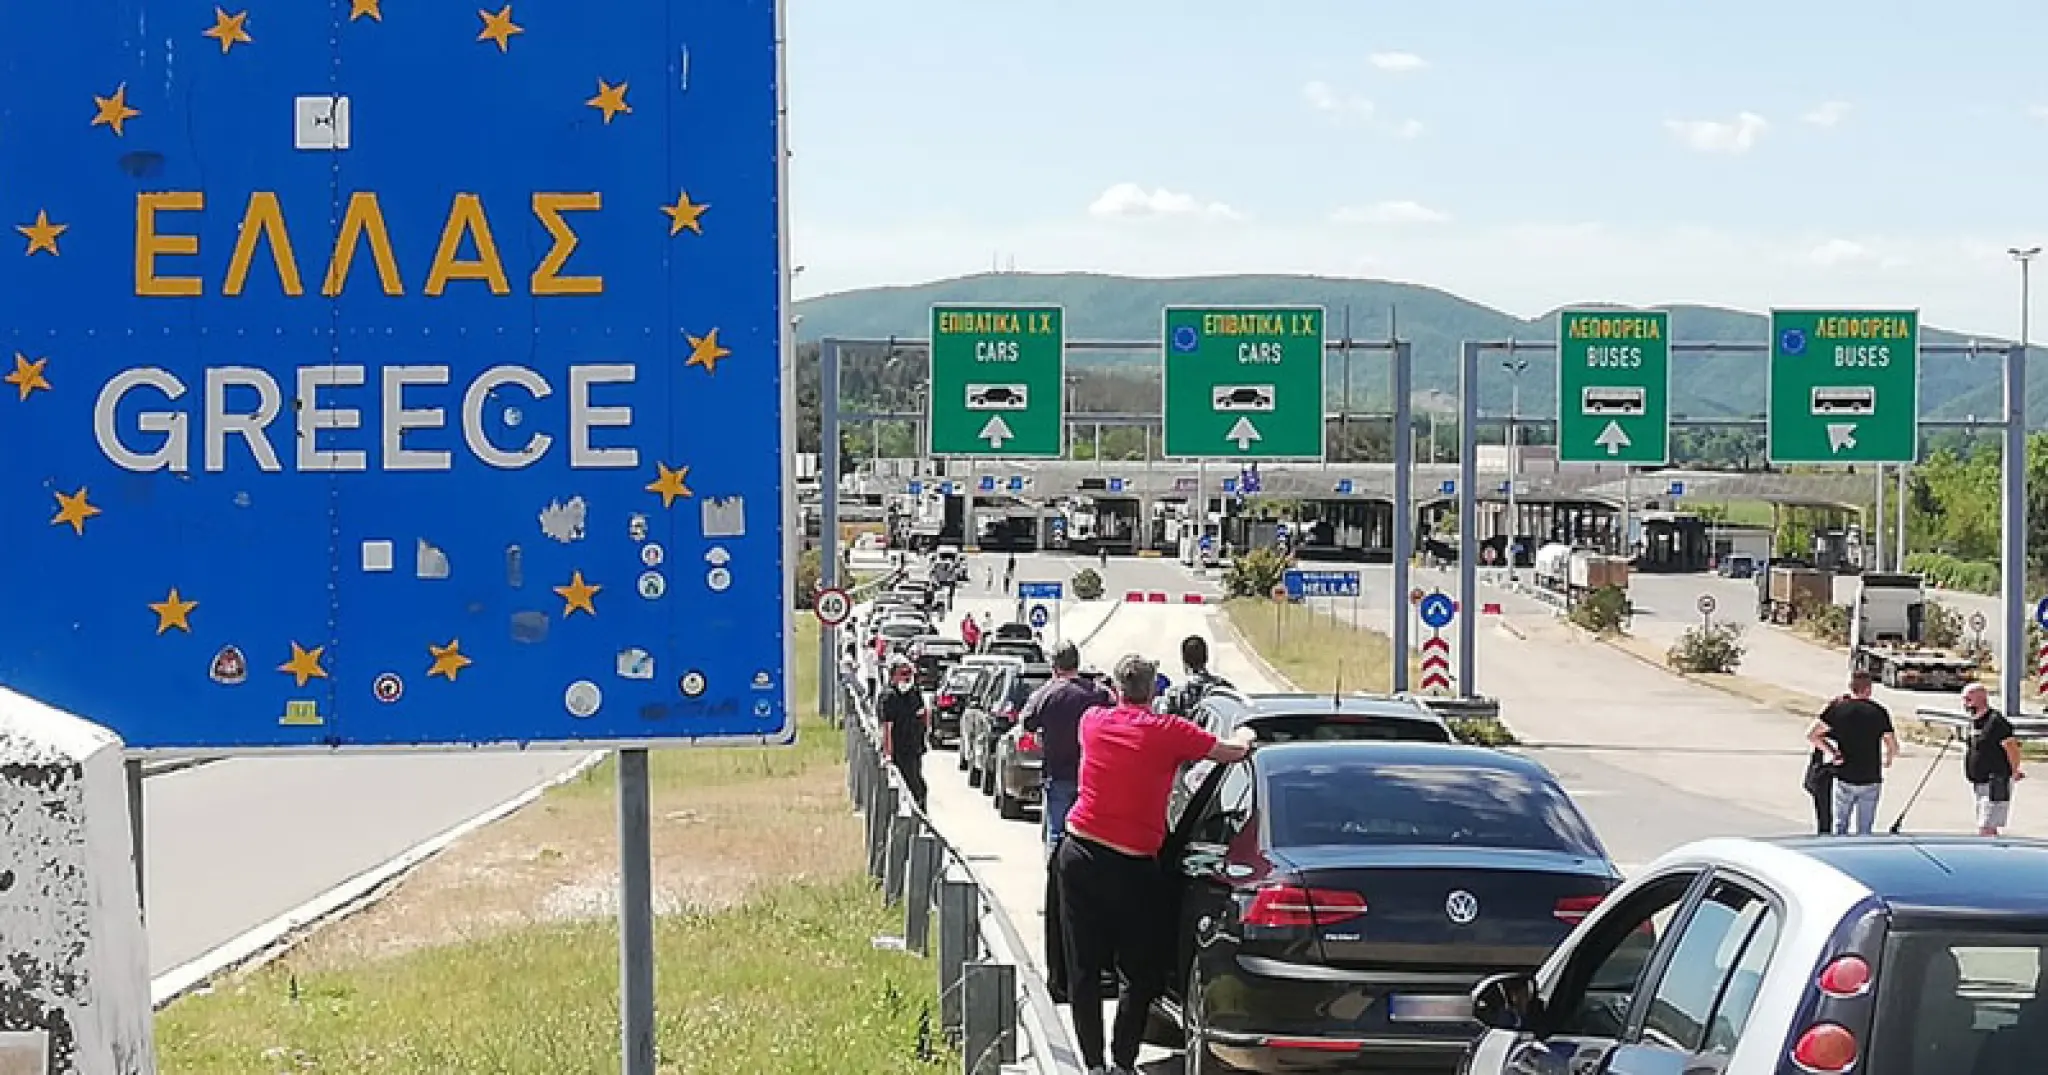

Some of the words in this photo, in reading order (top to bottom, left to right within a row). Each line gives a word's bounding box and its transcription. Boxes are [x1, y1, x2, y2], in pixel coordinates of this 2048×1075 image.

[135, 191, 605, 296] ΕΛΛΑΣ
[976, 340, 1019, 362] CARS
[1238, 342, 1281, 364] CARS
[1587, 345, 1642, 368] BUSES
[1835, 345, 1891, 368] BUSES
[94, 364, 639, 473] GREECE
[821, 598, 843, 614] 40
